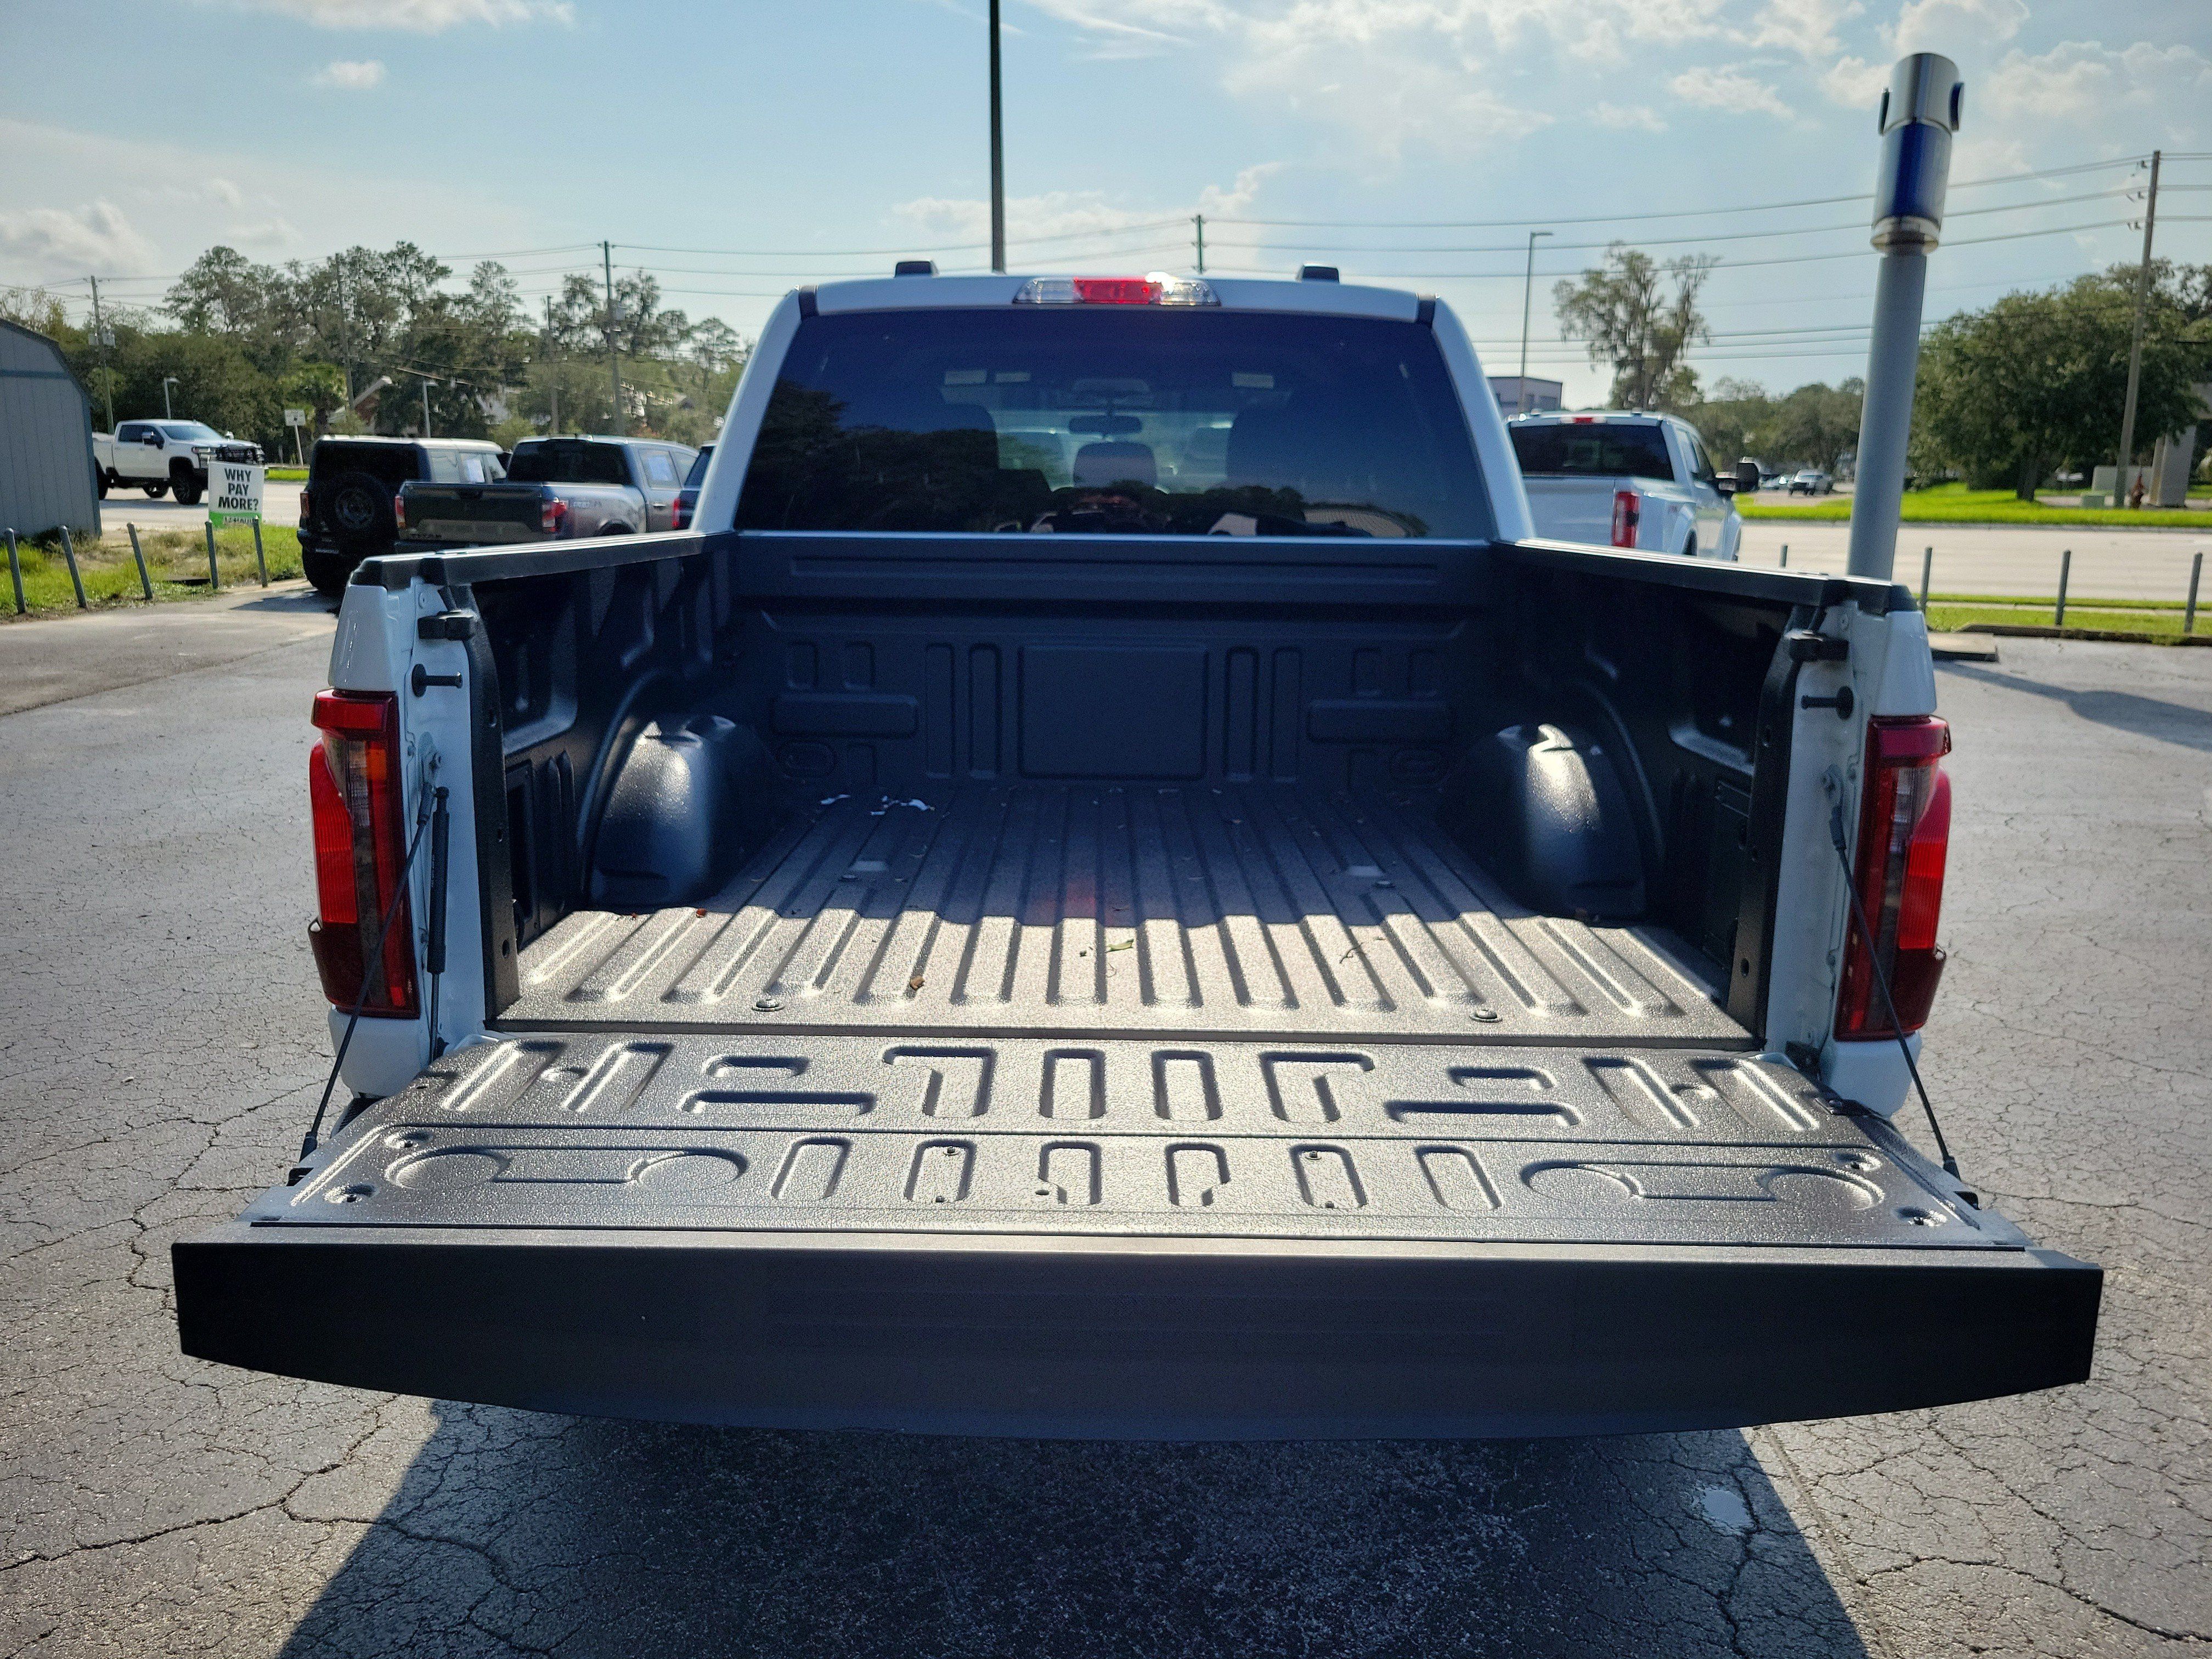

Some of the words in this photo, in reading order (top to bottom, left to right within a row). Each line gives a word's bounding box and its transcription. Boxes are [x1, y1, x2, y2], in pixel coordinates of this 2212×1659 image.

[224, 467, 251, 482] WHY
[228, 483, 249, 496] PAY
[218, 496, 259, 511] MORE?
